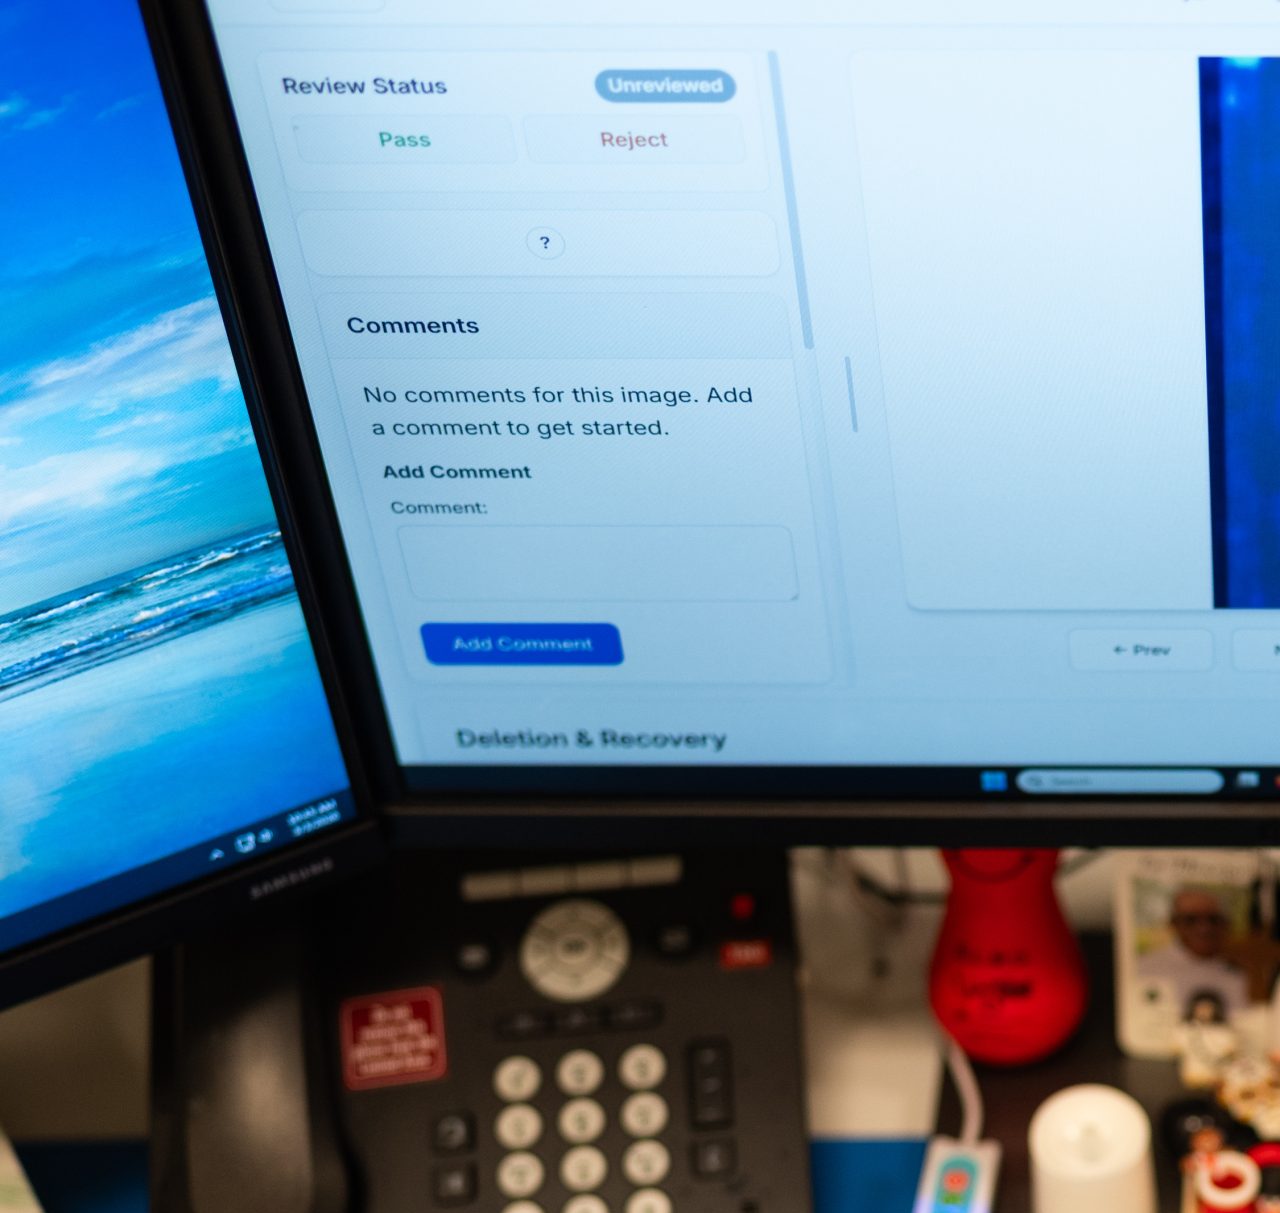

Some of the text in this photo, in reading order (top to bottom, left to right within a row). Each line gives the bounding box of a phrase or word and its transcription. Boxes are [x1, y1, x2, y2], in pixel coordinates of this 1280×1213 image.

[281, 77, 448, 95] Review Status
[607, 76, 724, 94] Unreviewed
[378, 131, 432, 148] Pass
[600, 131, 668, 151] Reject
[539, 236, 550, 249] ?
[346, 316, 480, 334] Comments
[363, 386, 753, 407] No comments for this image. Add
[372, 419, 669, 440] a comment to get started.
[383, 464, 532, 479] Add Comment
[390, 500, 488, 515] Comment:
[453, 636, 593, 652] Add Comment
[1132, 644, 1171, 657] Prev
[455, 729, 727, 752] Deletion & Recovery
